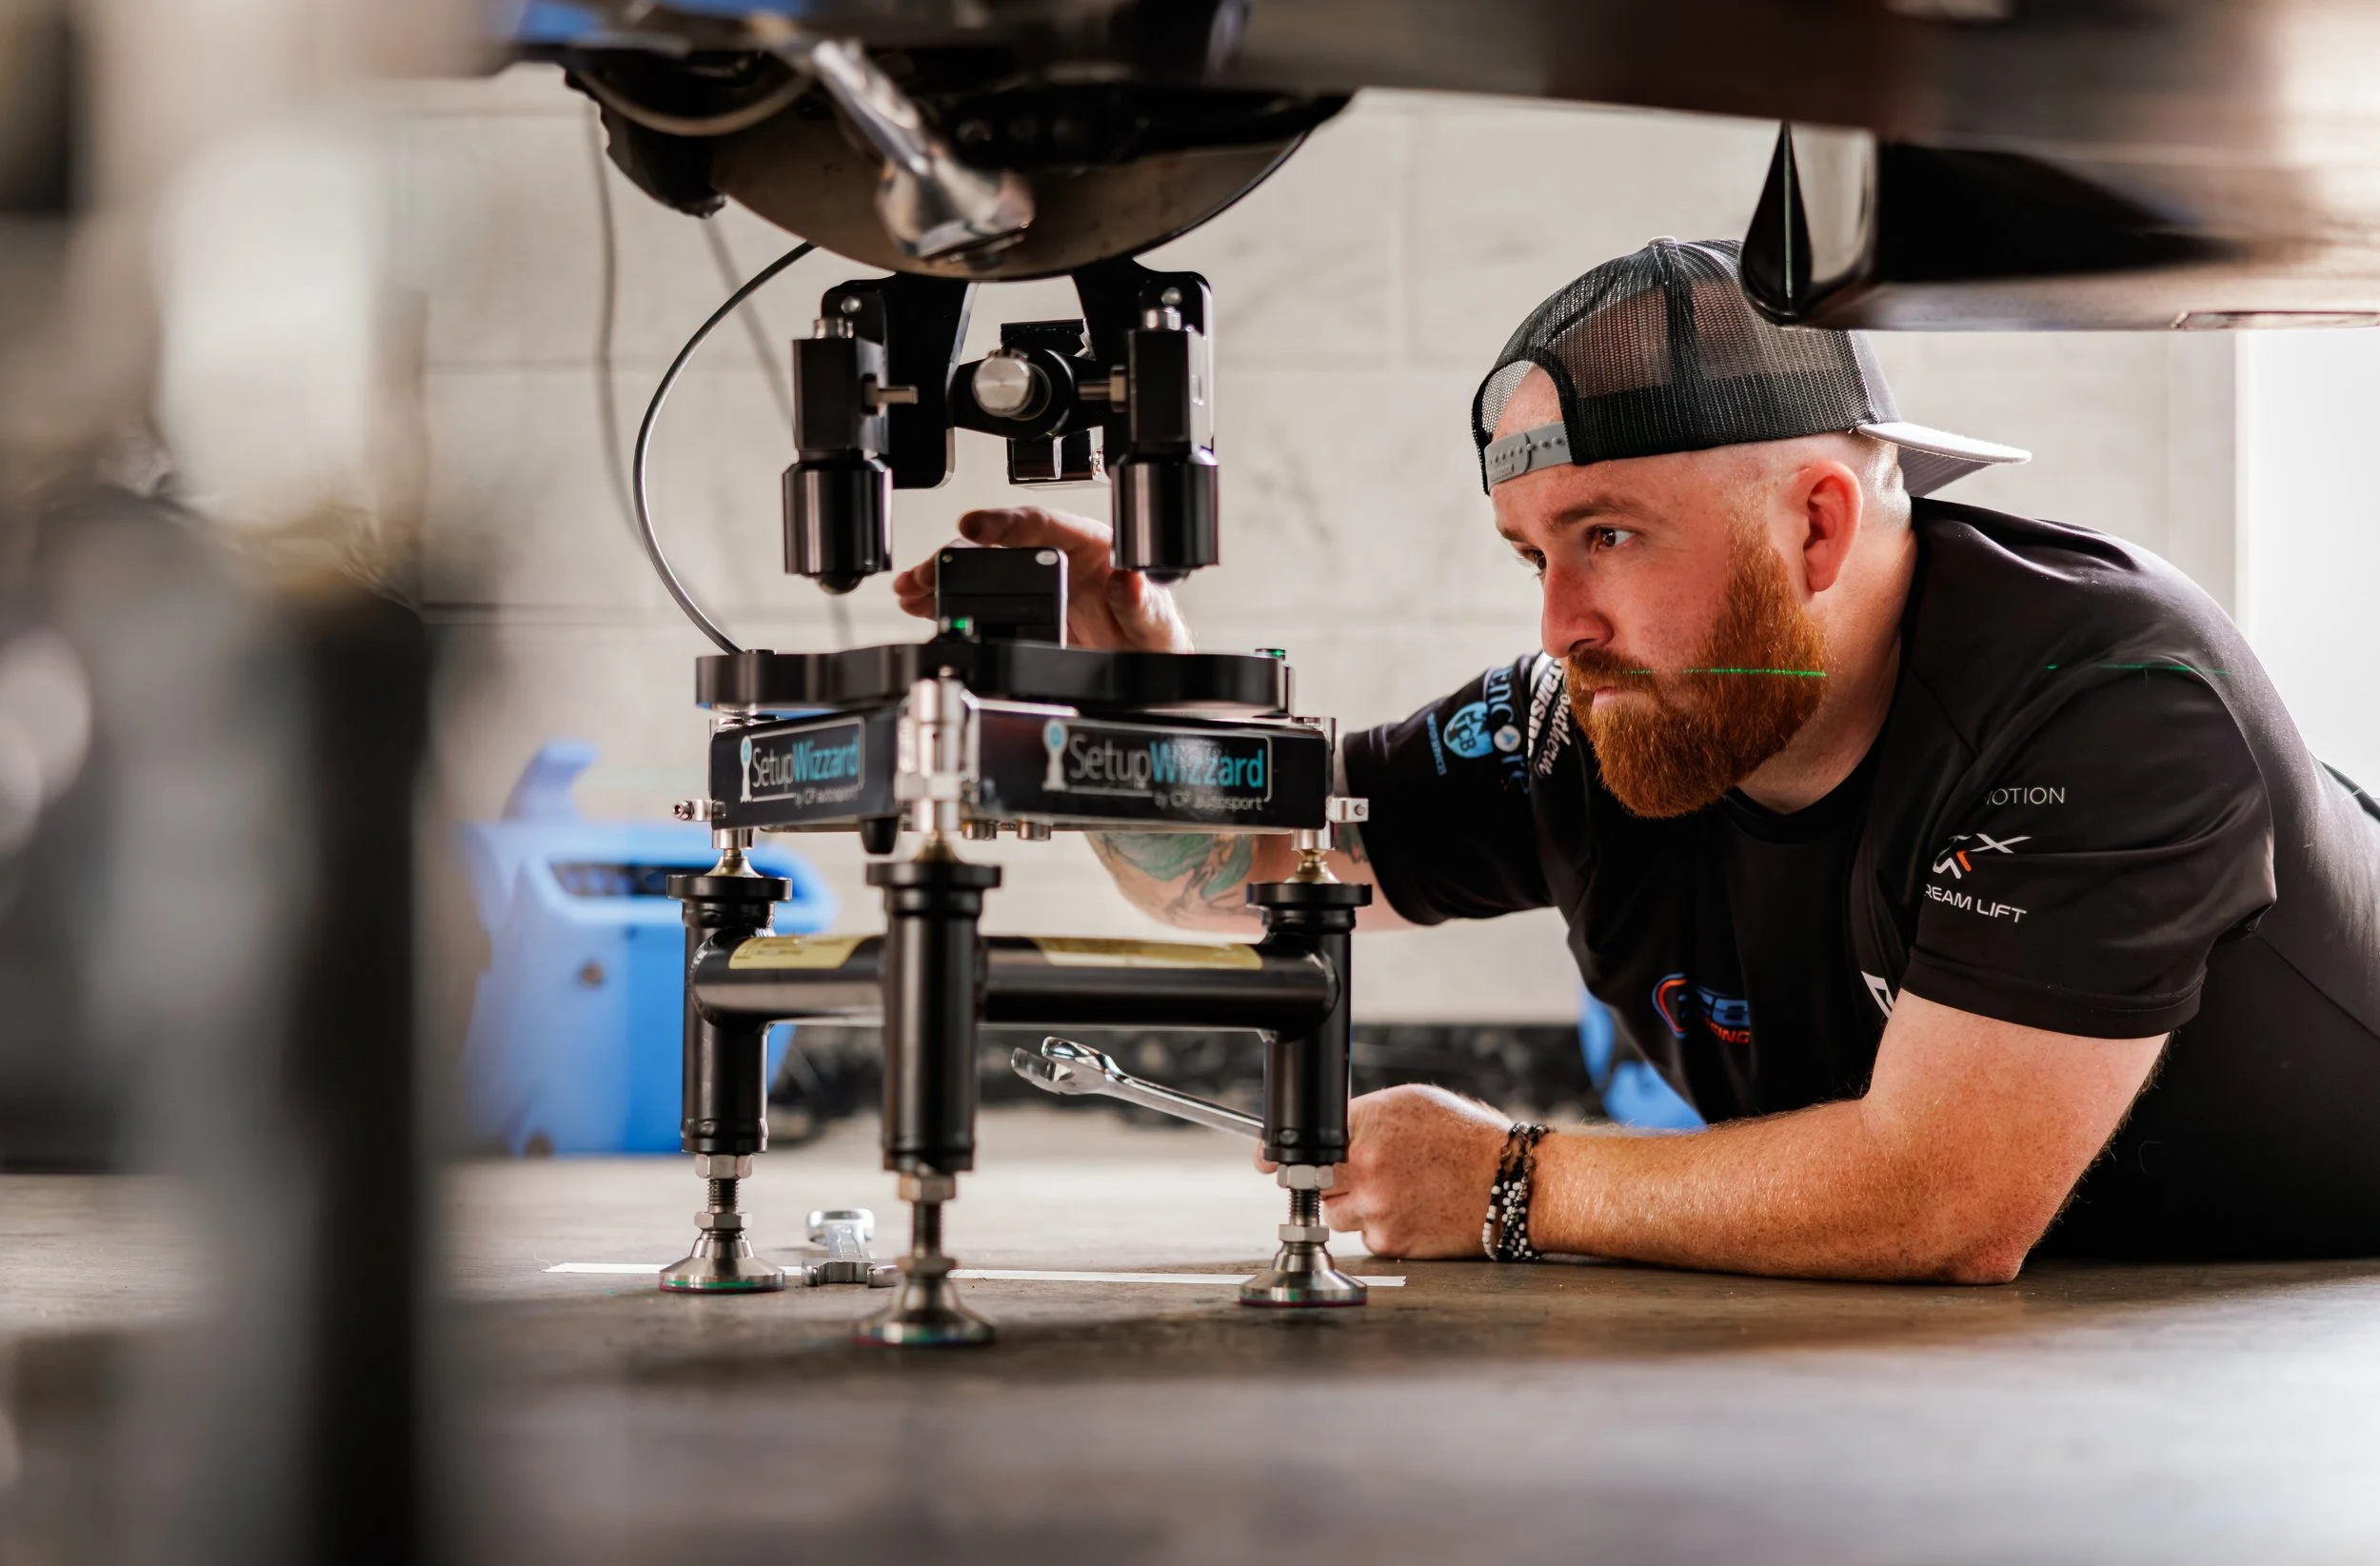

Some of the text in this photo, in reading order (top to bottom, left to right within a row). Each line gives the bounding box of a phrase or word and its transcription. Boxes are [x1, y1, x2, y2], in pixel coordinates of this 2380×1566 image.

[1538, 676, 1572, 775] outhern
[752, 732, 861, 791] SetupWizzard
[1069, 734, 1264, 788] SetupWizzard
[1976, 899, 2027, 923] LIFT
